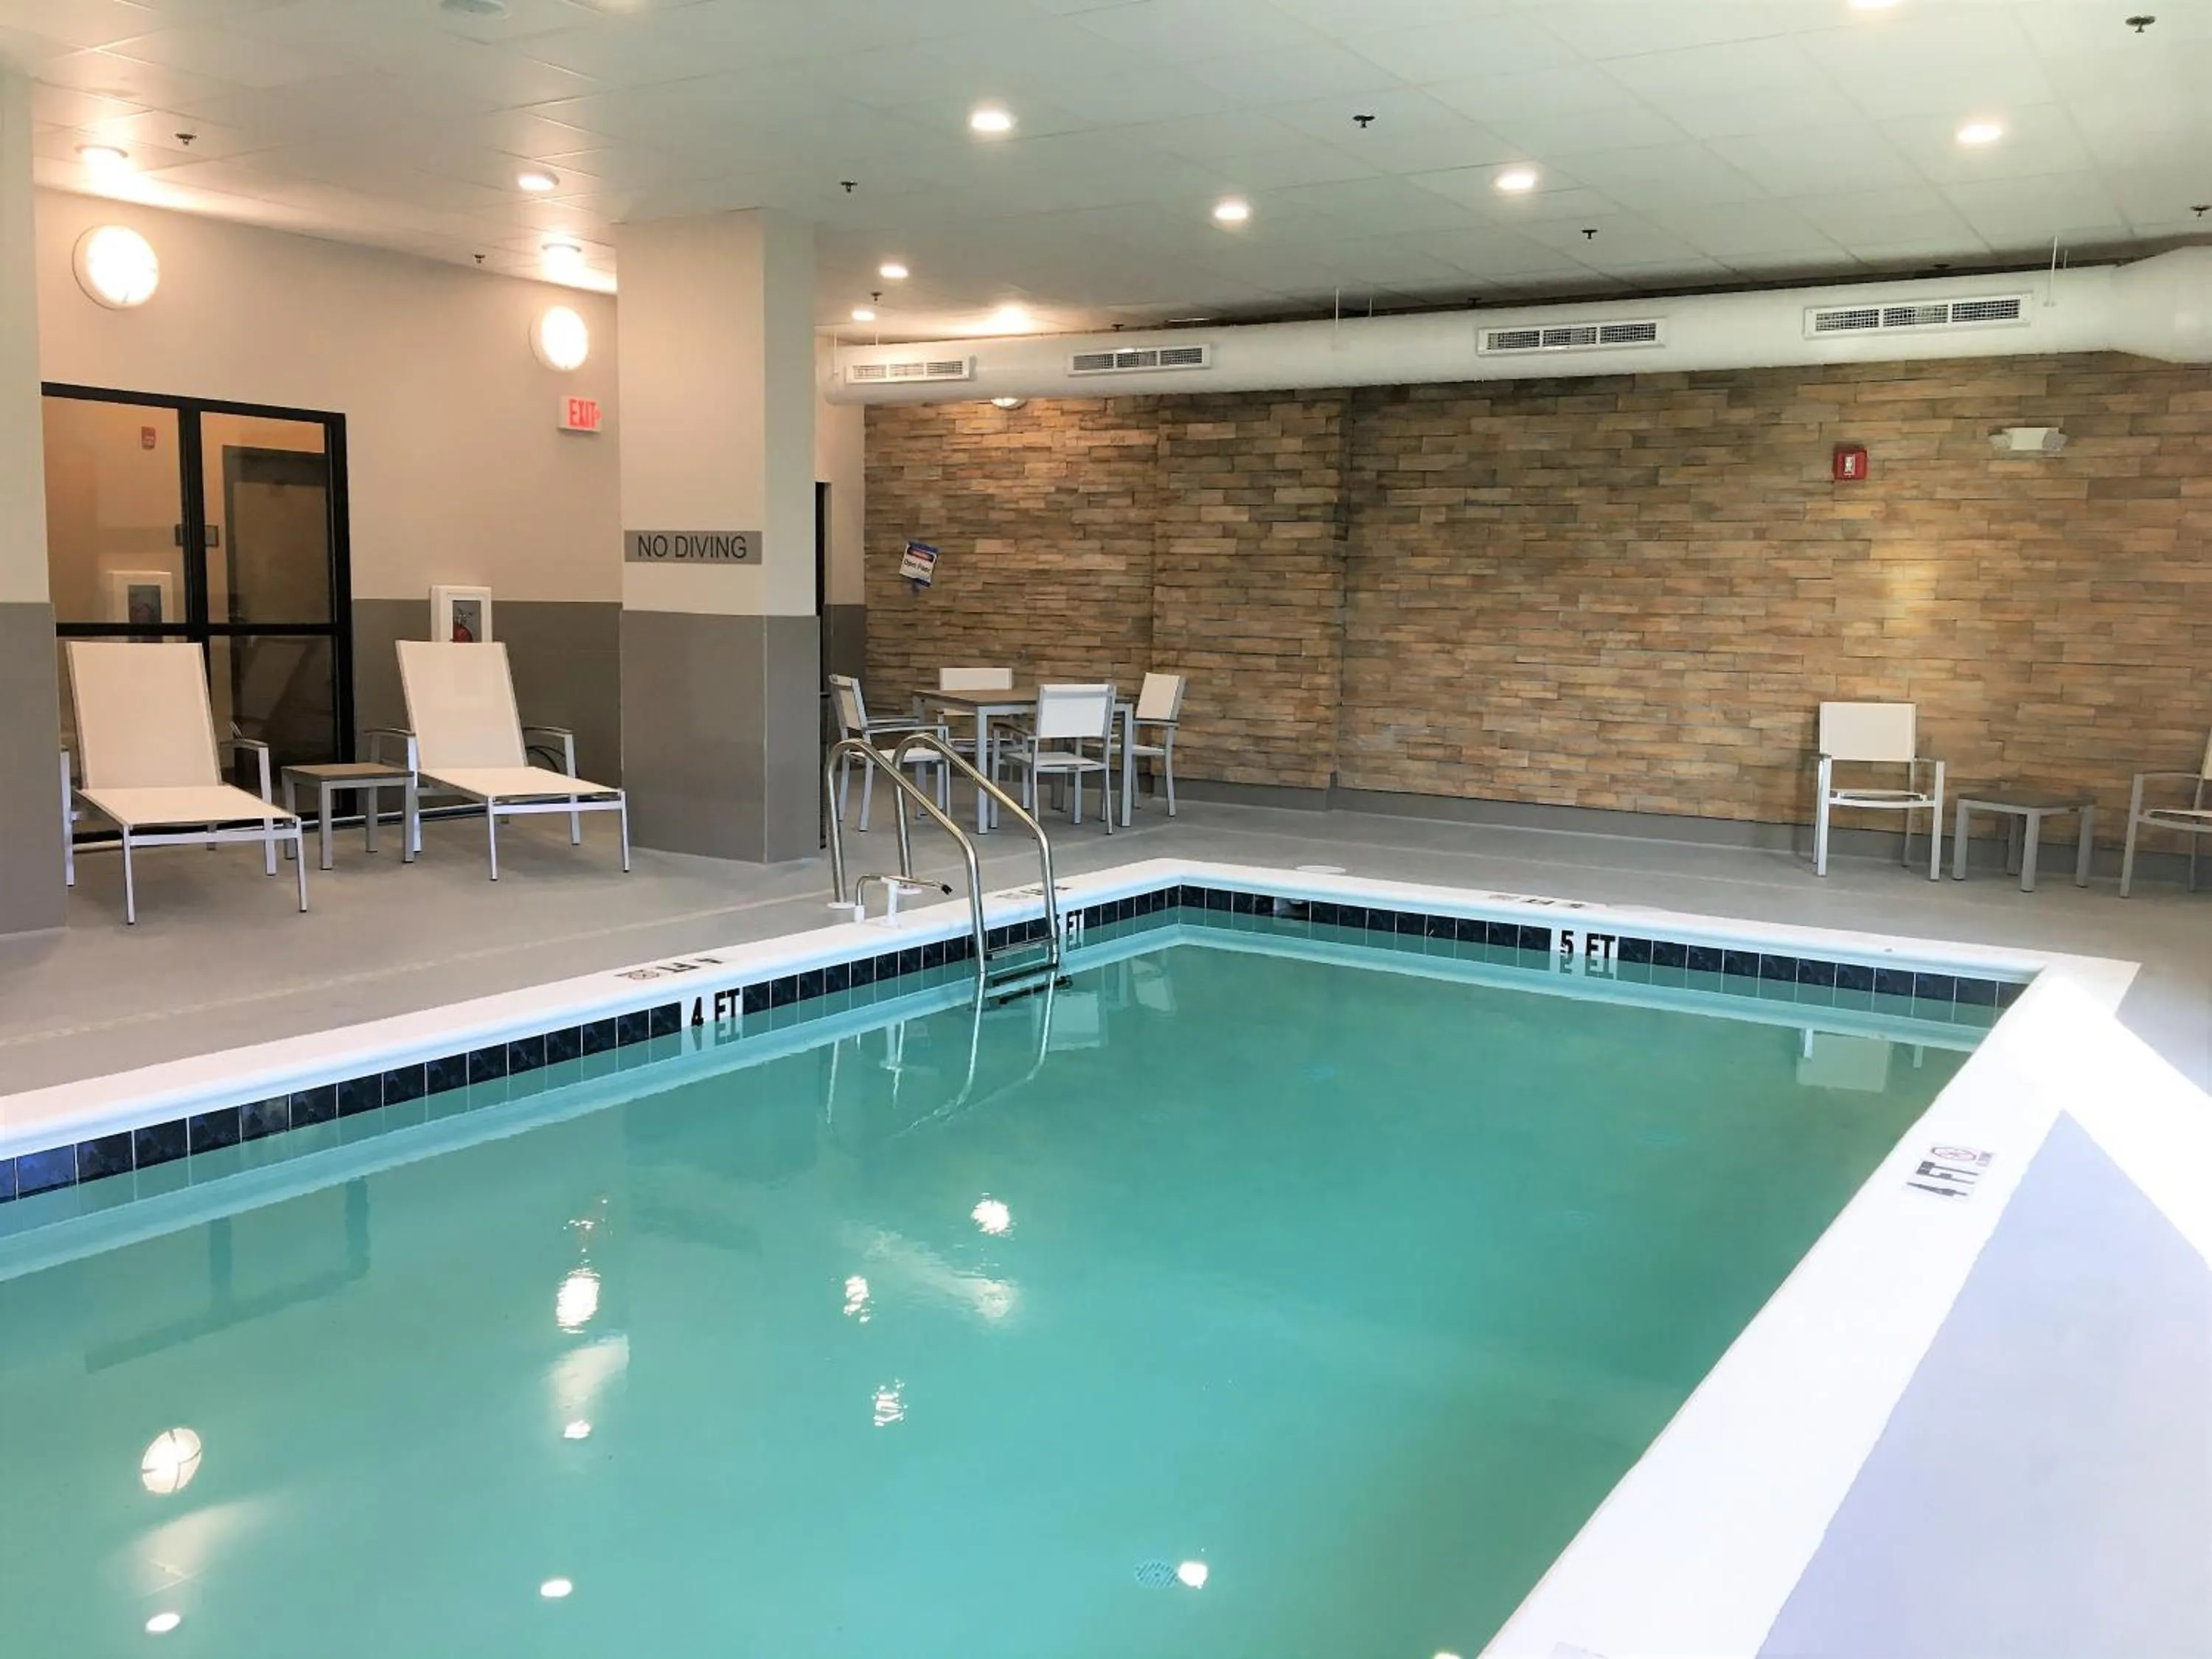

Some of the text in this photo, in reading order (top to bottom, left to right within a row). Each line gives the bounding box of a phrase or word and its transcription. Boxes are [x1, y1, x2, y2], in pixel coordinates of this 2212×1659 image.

[569, 399, 597, 428] EXIT
[638, 535, 746, 558] NO DIVING
[1066, 909, 1082, 934] FT
[1559, 930, 1615, 959] 5 FT
[691, 987, 740, 1026] 4 FT
